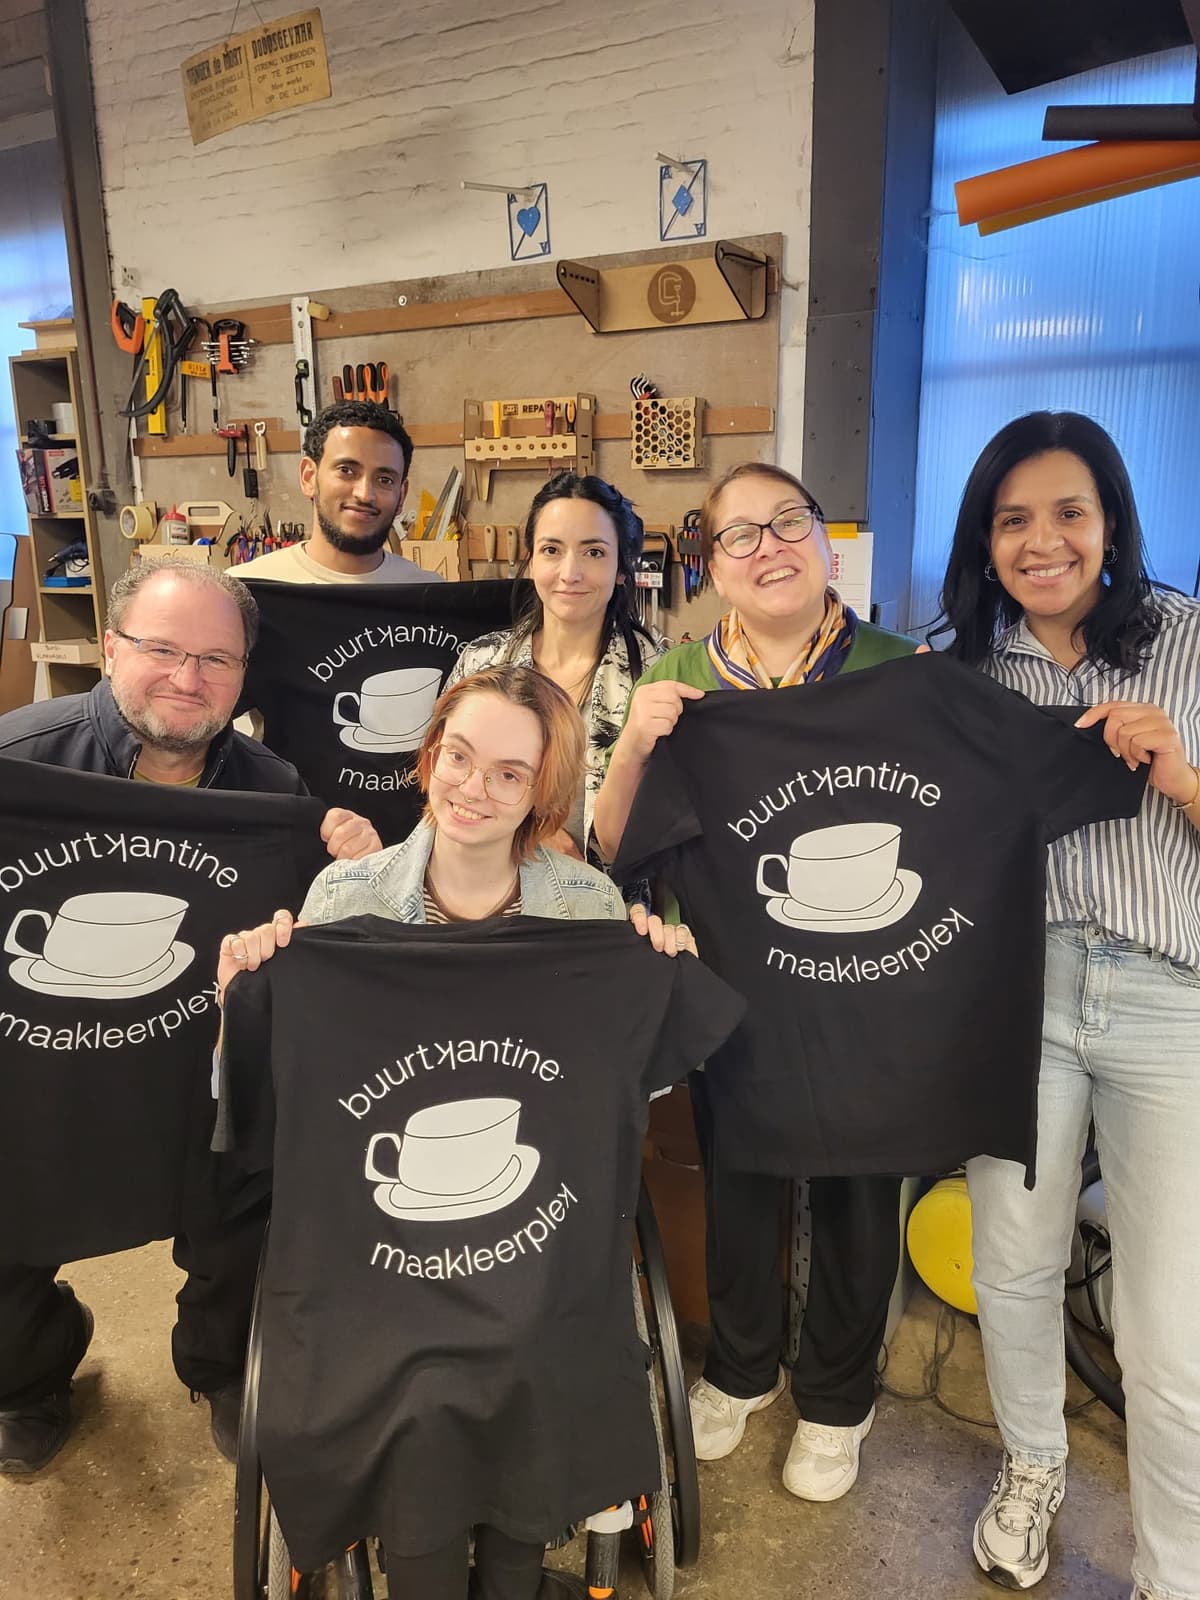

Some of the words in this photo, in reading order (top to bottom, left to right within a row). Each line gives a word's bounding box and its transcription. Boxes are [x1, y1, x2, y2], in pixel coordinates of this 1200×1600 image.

[272, 69, 281, 79] TE
[286, 60, 315, 75] ZETTEN
[338, 767, 421, 791] maakle
[727, 762, 941, 842] buurtkantine
[767, 907, 975, 983] maakleerplek
[370, 1182, 578, 1280] maakleerplek
